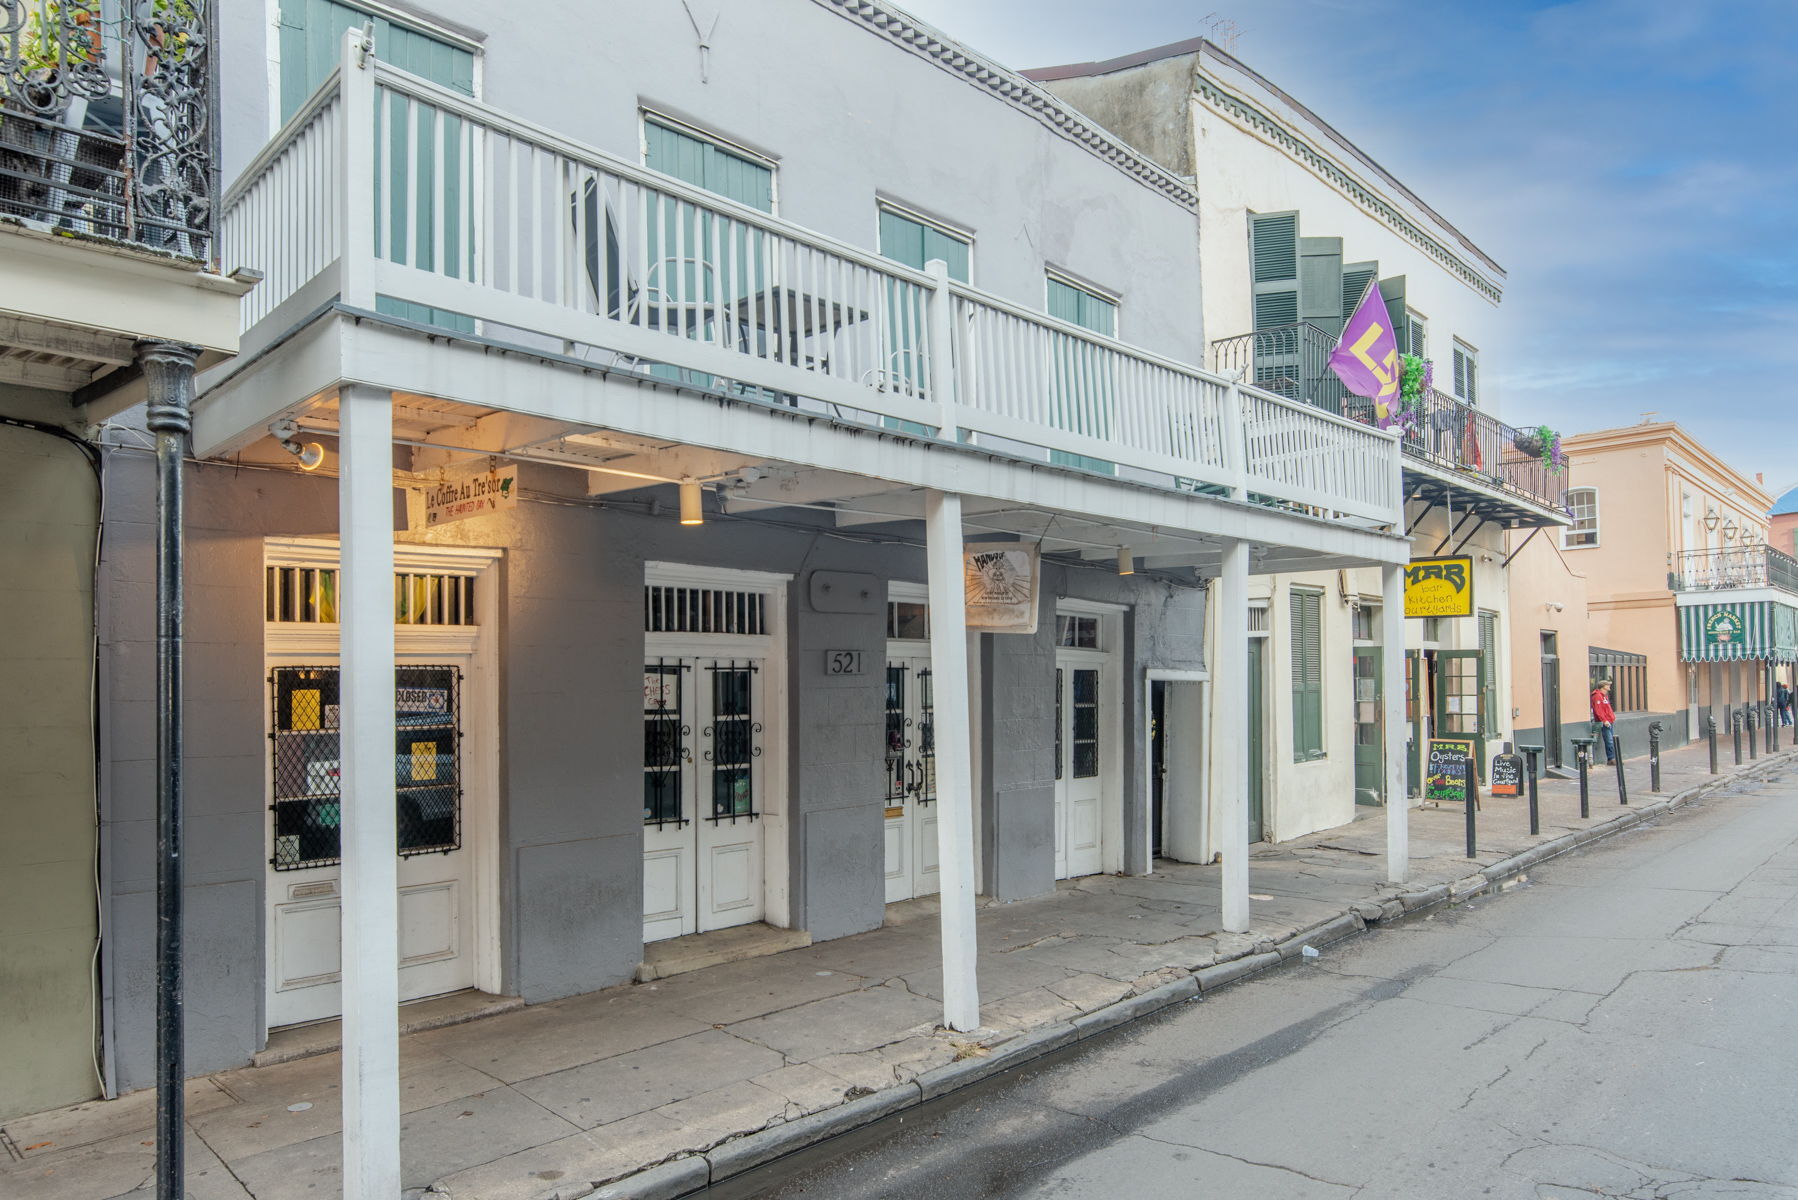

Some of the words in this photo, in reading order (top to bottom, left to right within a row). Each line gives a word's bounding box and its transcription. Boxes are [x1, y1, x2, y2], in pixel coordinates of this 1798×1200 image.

[426, 491, 435, 509] Le
[436, 484, 459, 507] Coffre
[460, 481, 471, 501] Au
[1421, 584, 1443, 594] bar
[1404, 603, 1462, 615] ourtyards
[832, 652, 861, 674] 521
[1430, 751, 1466, 764] Oysters
[1494, 766, 1517, 774] Music
